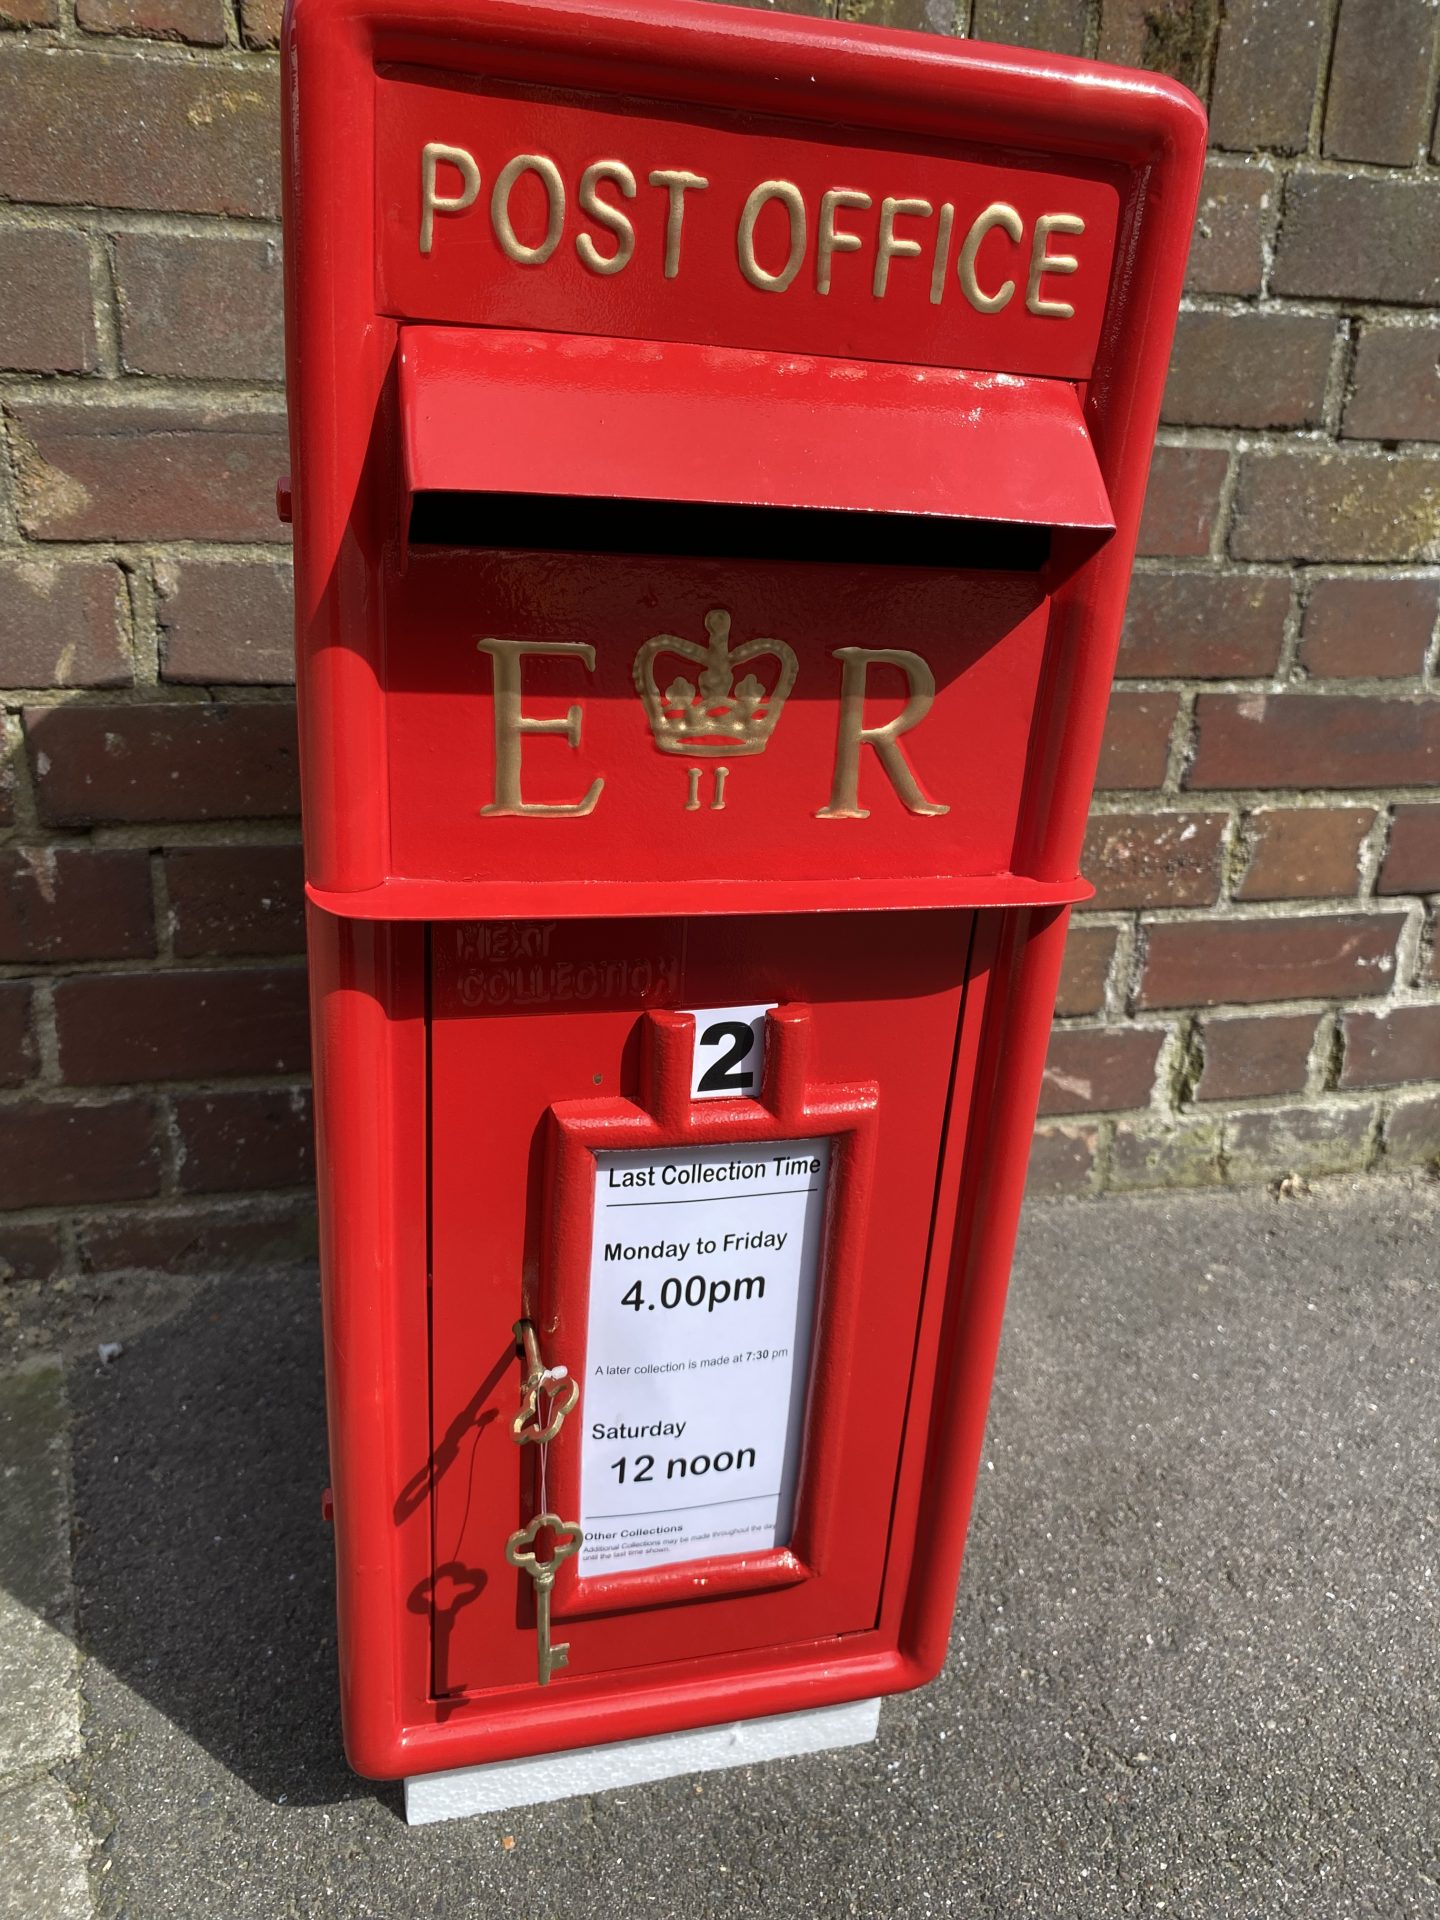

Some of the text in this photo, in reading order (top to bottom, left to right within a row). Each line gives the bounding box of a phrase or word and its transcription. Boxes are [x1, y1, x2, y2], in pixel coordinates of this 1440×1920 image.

[419, 142, 1086, 318] POST OFFICE
[477, 638, 951, 819] E R
[697, 1021, 755, 1093] 2
[608, 1156, 821, 1188] Last Collection Time
[604, 1231, 788, 1262] Monday to Friday
[620, 1274, 766, 1313] 4.00pm
[594, 1347, 788, 1376] A later collection is made at 7:30 pm
[592, 1420, 687, 1440] Saturday
[610, 1446, 756, 1484] 12 noon
[583, 1542, 620, 1553] Additional
[621, 1539, 661, 1550] Collections
[662, 1537, 678, 1546] may
[679, 1535, 689, 1543] be
[690, 1532, 711, 1541] made
[712, 1526, 749, 1539] throughout
[751, 1524, 762, 1532] the
[584, 1524, 683, 1541] Other Collections
[582, 1551, 599, 1561] until
[600, 1550, 612, 1560] the
[613, 1549, 627, 1558] last
[628, 1547, 644, 1557] time
